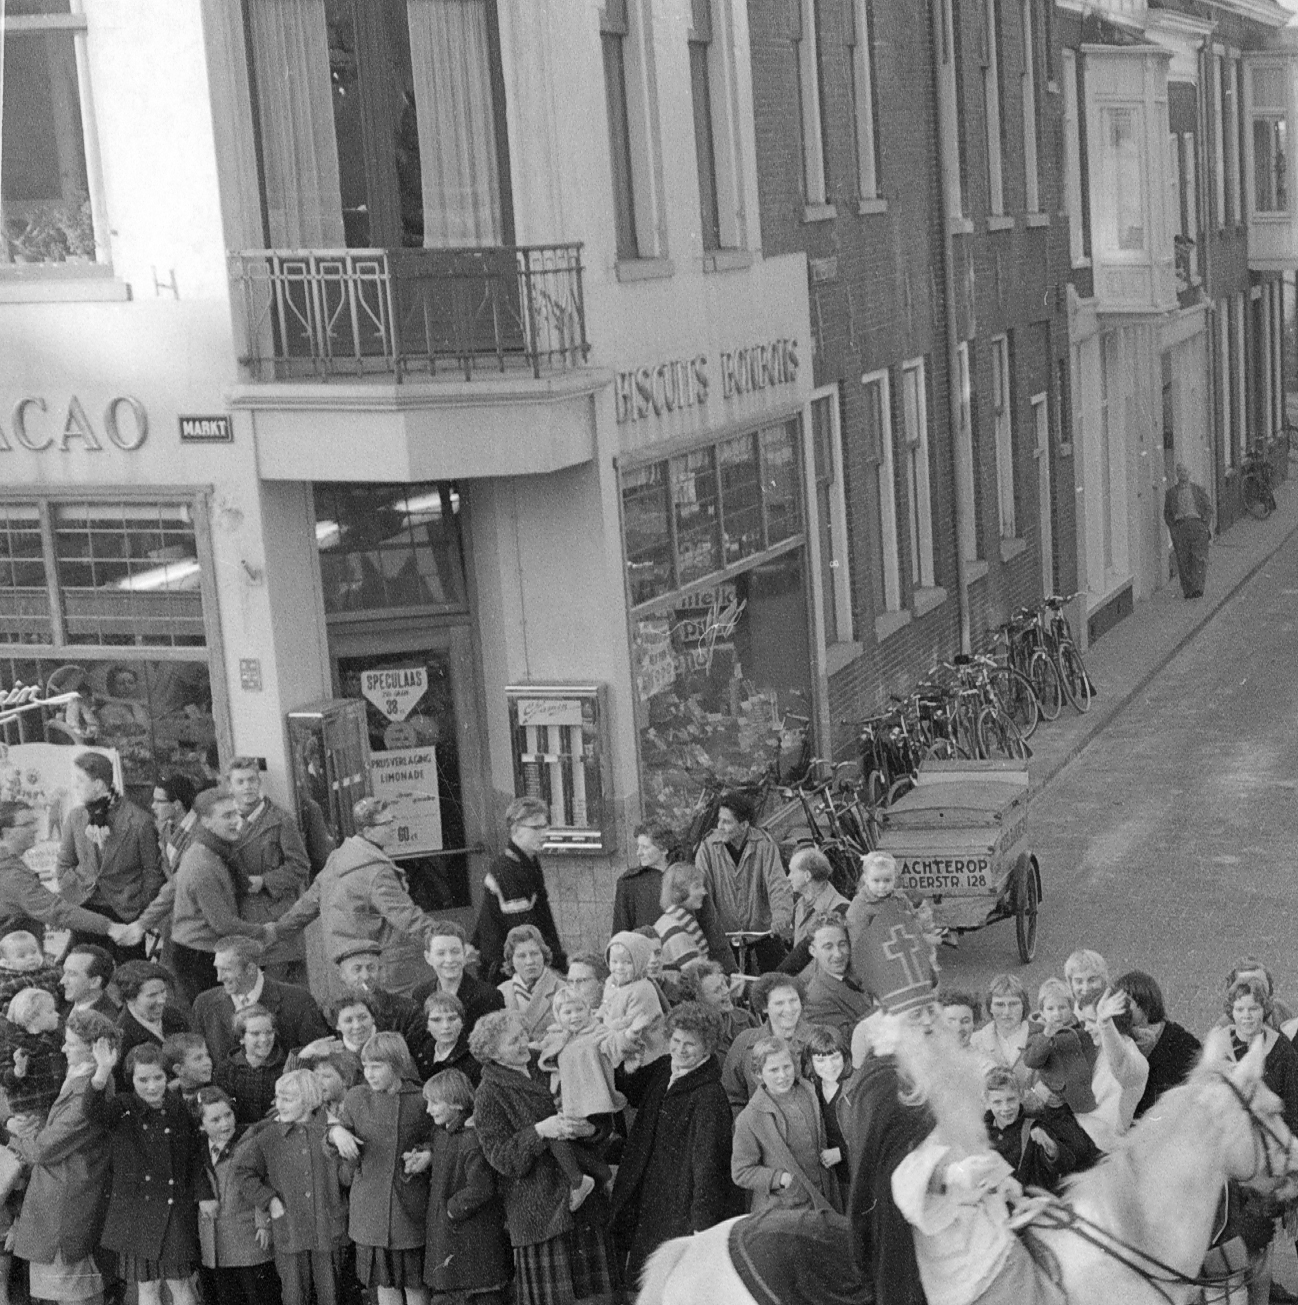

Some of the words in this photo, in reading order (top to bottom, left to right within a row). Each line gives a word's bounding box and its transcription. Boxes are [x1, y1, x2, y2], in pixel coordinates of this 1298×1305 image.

[183, 420, 227, 437] MARKT
[366, 670, 423, 691] SPECULAAS
[386, 698, 398, 715] 38
[380, 769, 425, 784] LIMONADE
[901, 859, 988, 875] ACHTEROP
[966, 874, 987, 888] 128
